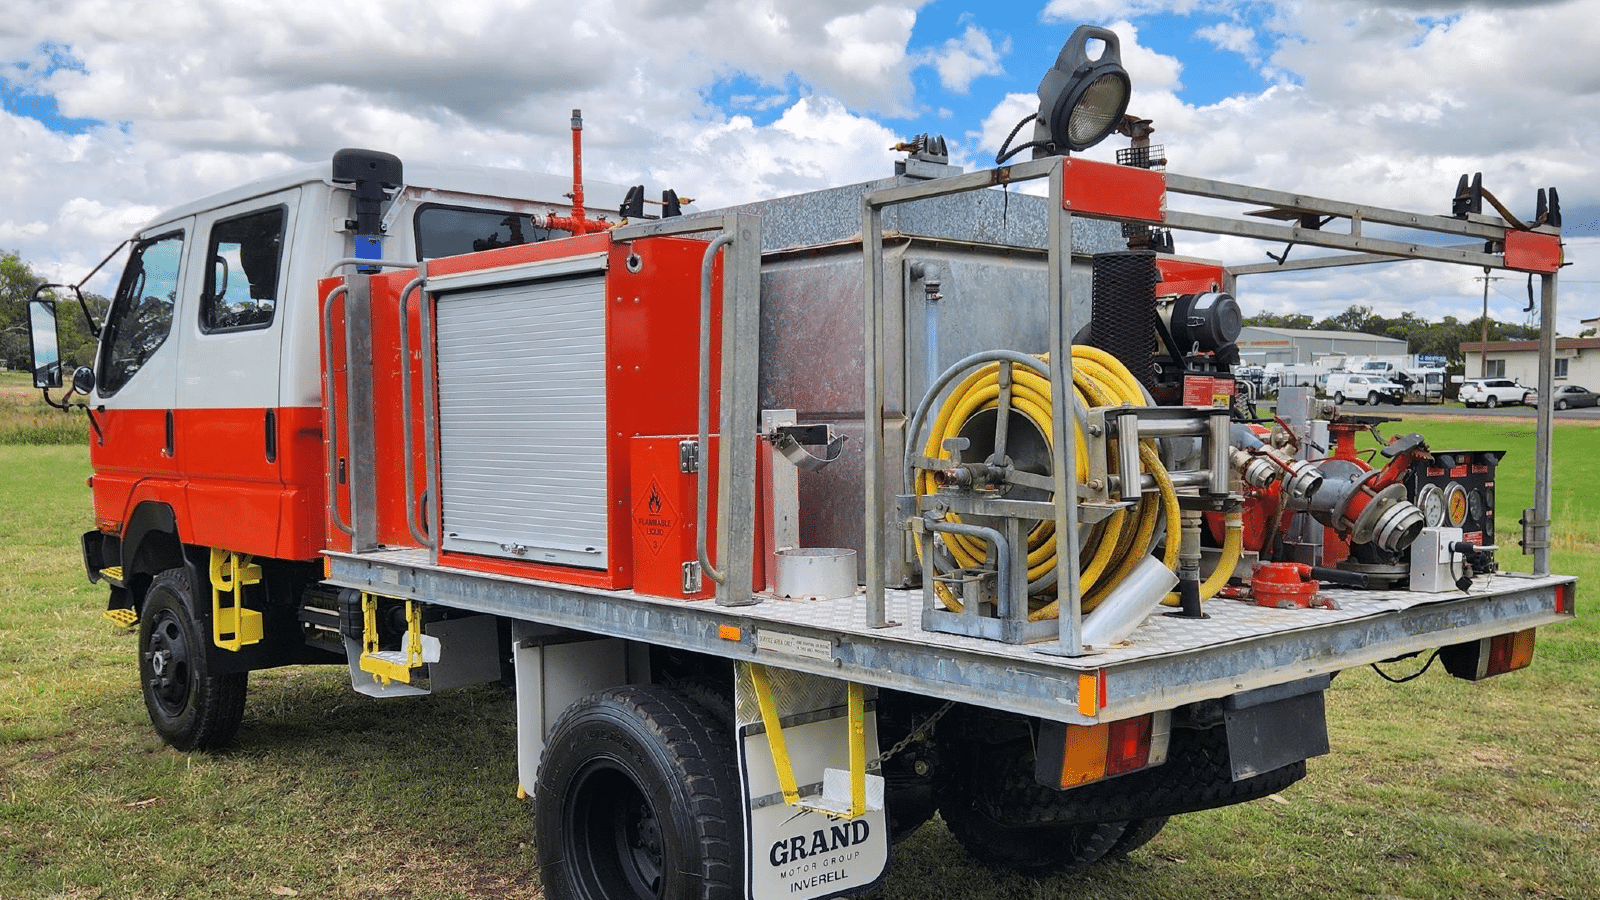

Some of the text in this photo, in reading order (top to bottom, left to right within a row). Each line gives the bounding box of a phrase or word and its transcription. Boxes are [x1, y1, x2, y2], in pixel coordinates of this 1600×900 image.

[639, 518, 671, 527] FLAMMABLE
[647, 528, 663, 536] LIQUID
[653, 540, 658, 549] 3
[769, 819, 870, 867] GRAND
[780, 851, 860, 880] MOTOR GROUP
[790, 869, 849, 893] INVERELL
